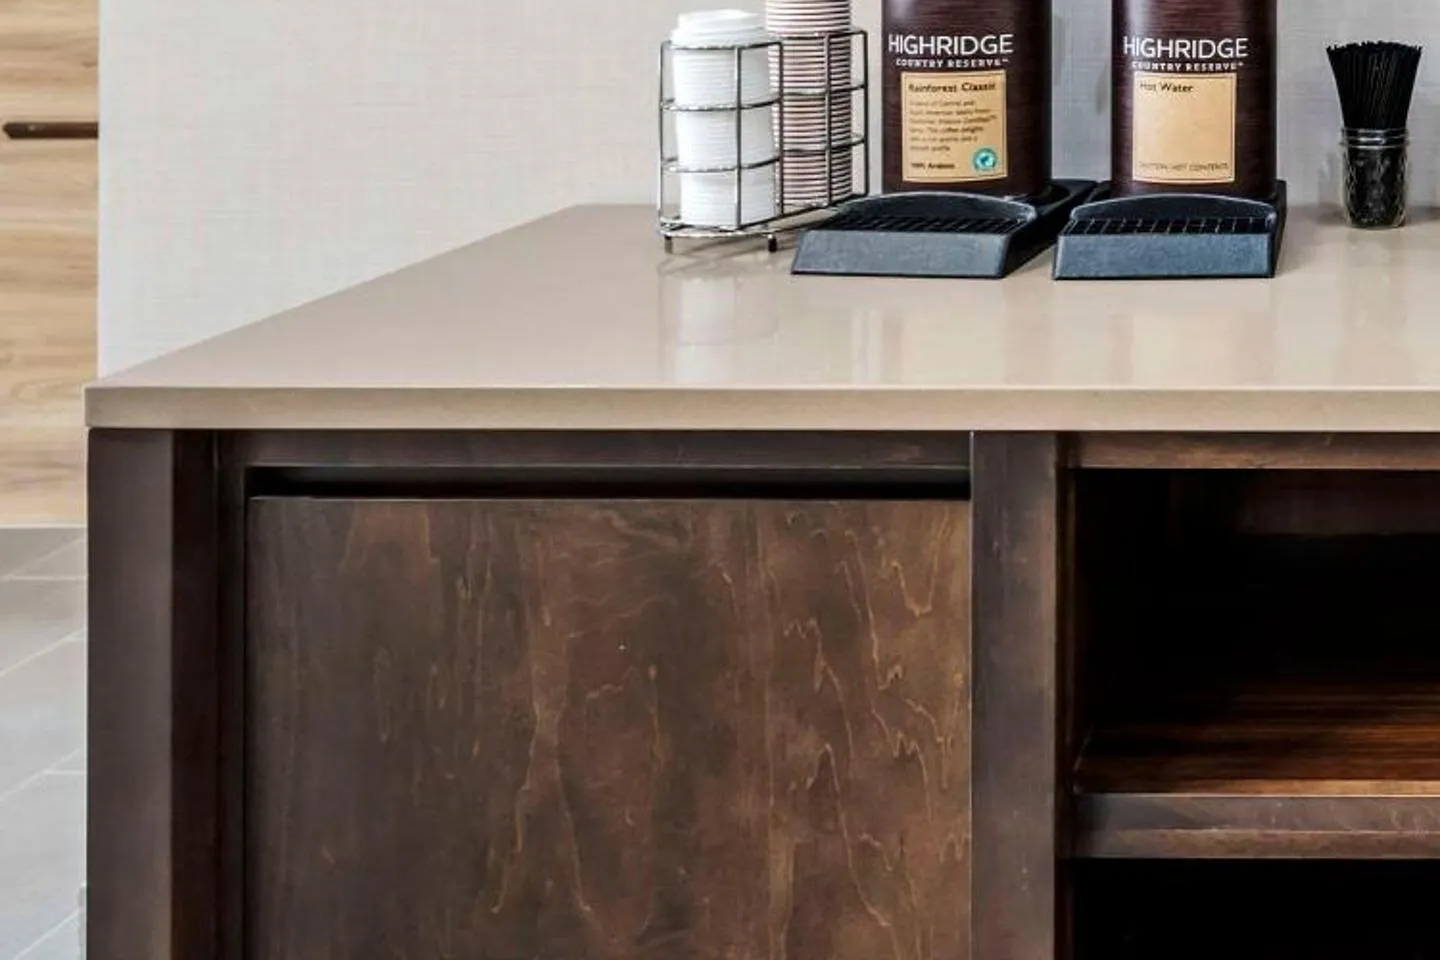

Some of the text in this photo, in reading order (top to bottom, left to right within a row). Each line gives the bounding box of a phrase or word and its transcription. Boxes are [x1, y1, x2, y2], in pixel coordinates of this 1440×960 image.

[888, 33, 1014, 55] HIGHRIDGE
[1123, 36, 1249, 58] HIGHRIDGE
[896, 58, 944, 68] COUNTRY
[1132, 61, 1182, 71] COUNTRY
[908, 82, 995, 92] Rainforest Classic
[1160, 82, 1194, 92] Water
